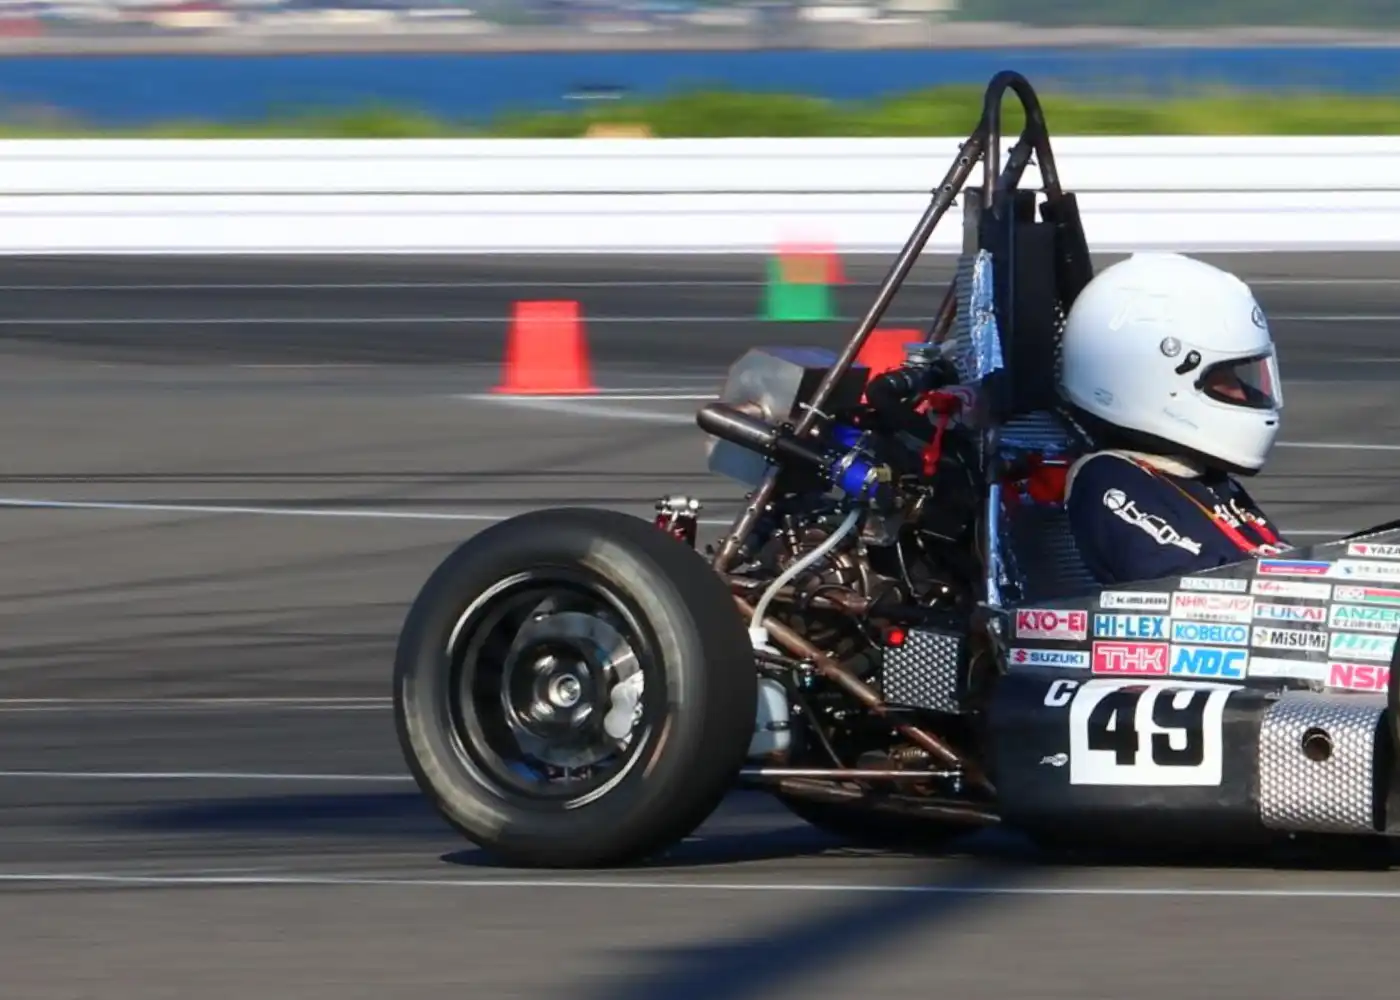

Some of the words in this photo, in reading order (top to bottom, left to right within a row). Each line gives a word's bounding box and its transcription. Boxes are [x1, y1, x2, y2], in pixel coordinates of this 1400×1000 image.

[1018, 611, 1086, 632] KYO-EI
[1256, 604, 1323, 619] FUKAI
[1095, 615, 1164, 637] HI-LEX
[1175, 624, 1246, 642] KOBELCO
[1030, 652, 1084, 664] SUZUKI
[1098, 645, 1164, 670] THK
[1171, 647, 1246, 677] NDC
[1330, 663, 1390, 690] NSK
[1044, 679, 1079, 706] C
[1087, 684, 1210, 767] 49
